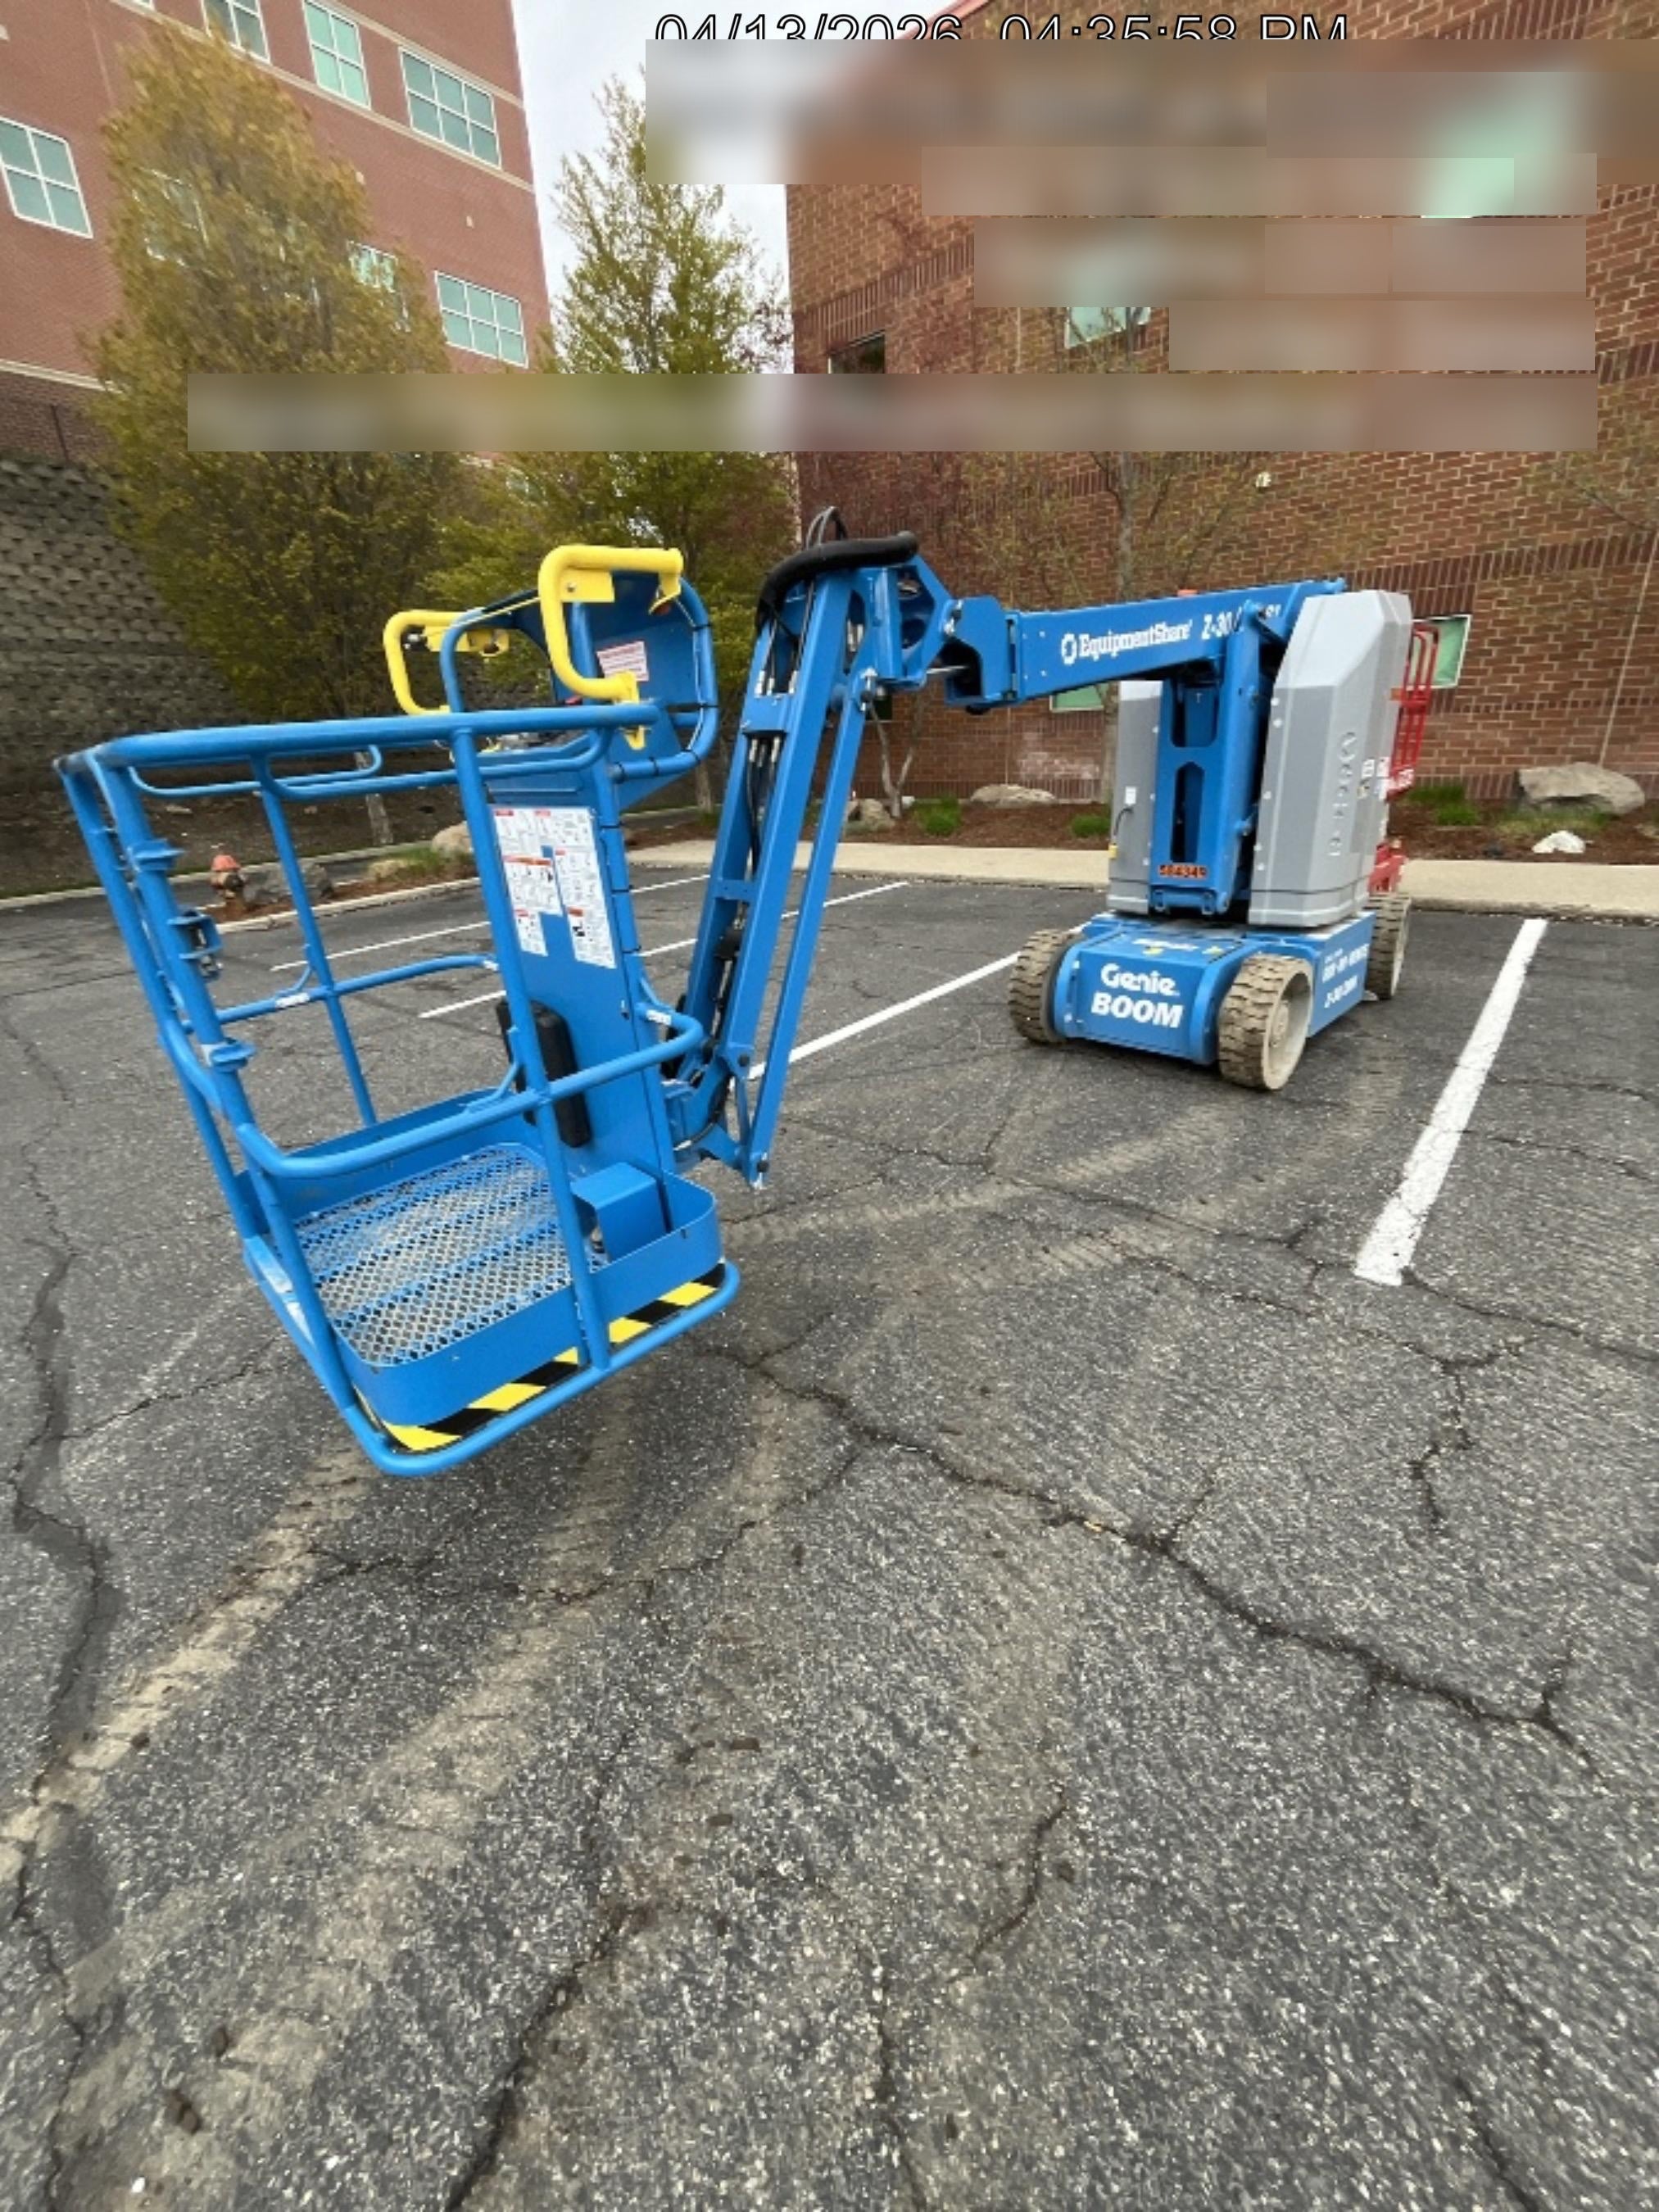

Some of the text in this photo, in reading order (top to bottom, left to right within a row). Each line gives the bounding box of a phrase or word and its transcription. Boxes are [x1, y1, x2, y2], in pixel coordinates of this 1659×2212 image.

[1078, 620, 1192, 662] EquipmentShare
[1100, 963, 1179, 996] Genie
[1090, 991, 1184, 1028] BOOM
